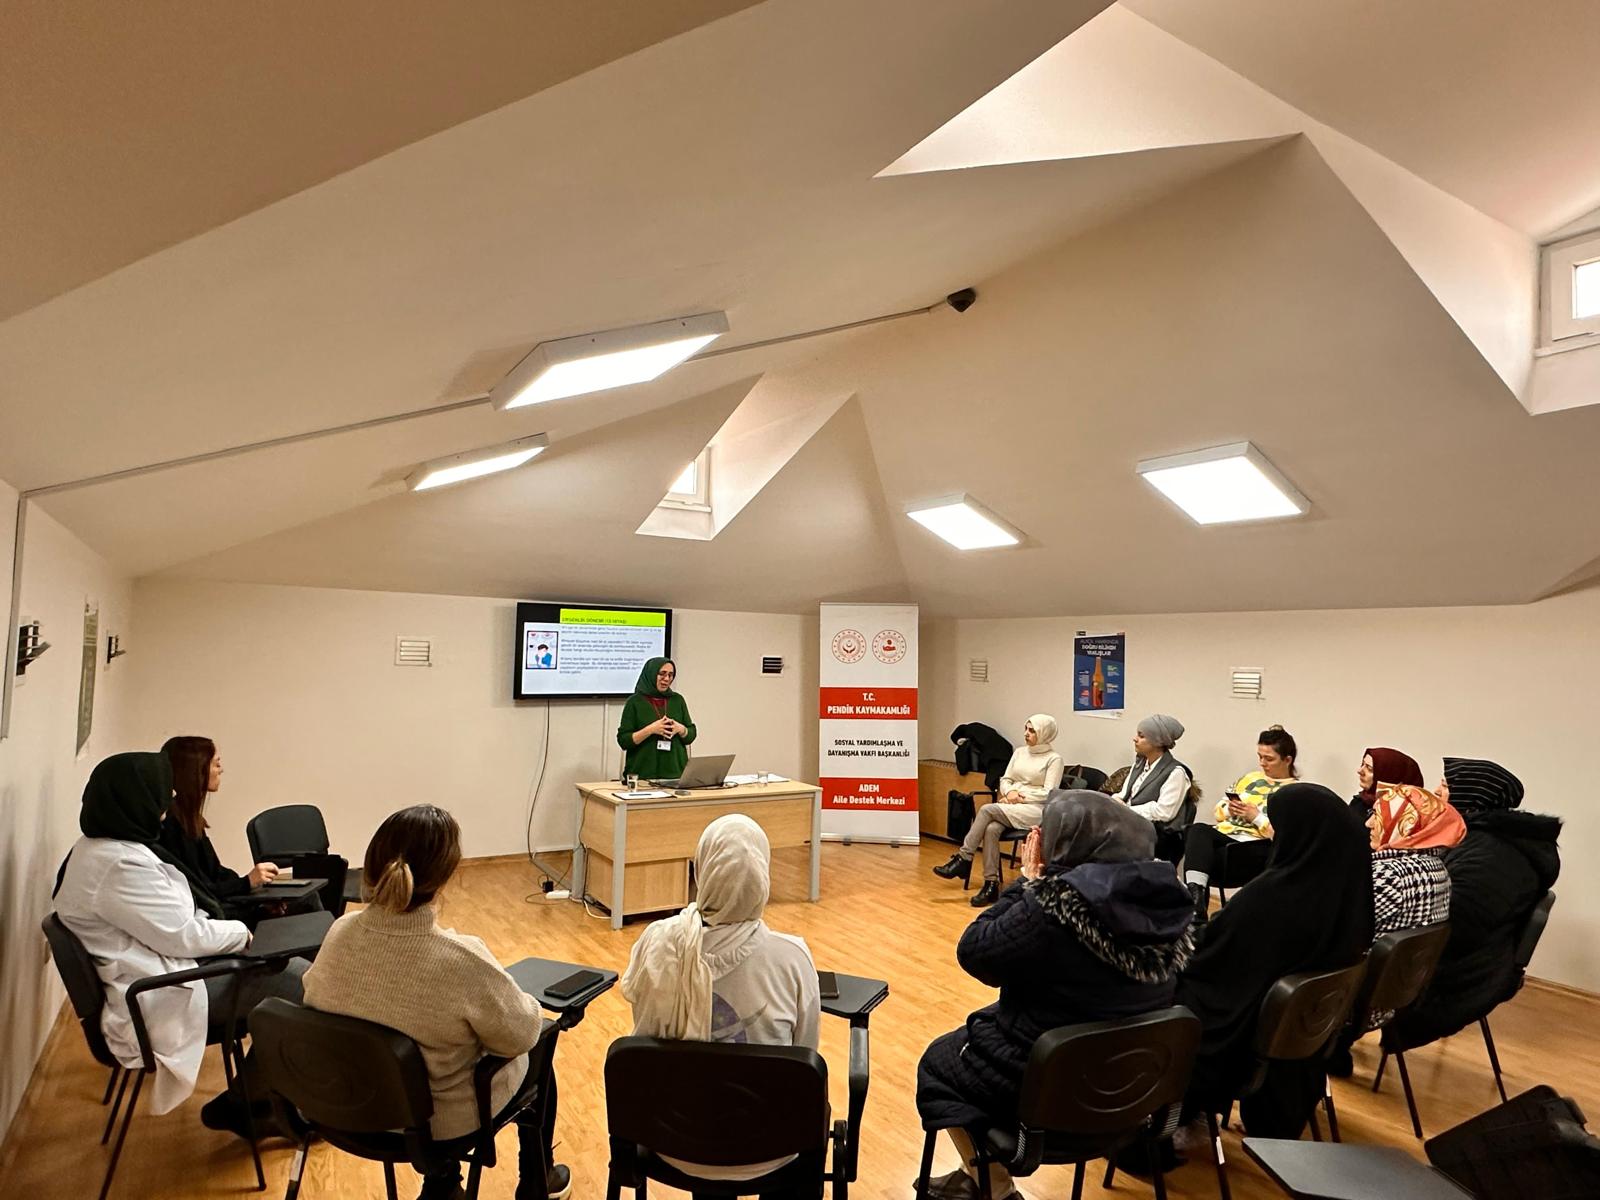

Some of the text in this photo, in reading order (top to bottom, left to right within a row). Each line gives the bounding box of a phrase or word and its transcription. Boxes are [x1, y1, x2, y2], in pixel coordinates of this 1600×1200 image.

[862, 692, 876, 701] T.C.
[827, 704, 910, 715] PENDİK KAYMAKAMLIĞI
[856, 739, 896, 747] YARDIMLAŞMA
[827, 749, 859, 758] DAYANIŞMA
[877, 749, 910, 758] BAŞKANLIĞI
[858, 783, 880, 792] ADEM
[832, 795, 905, 805] Aile Destek Merkezi
